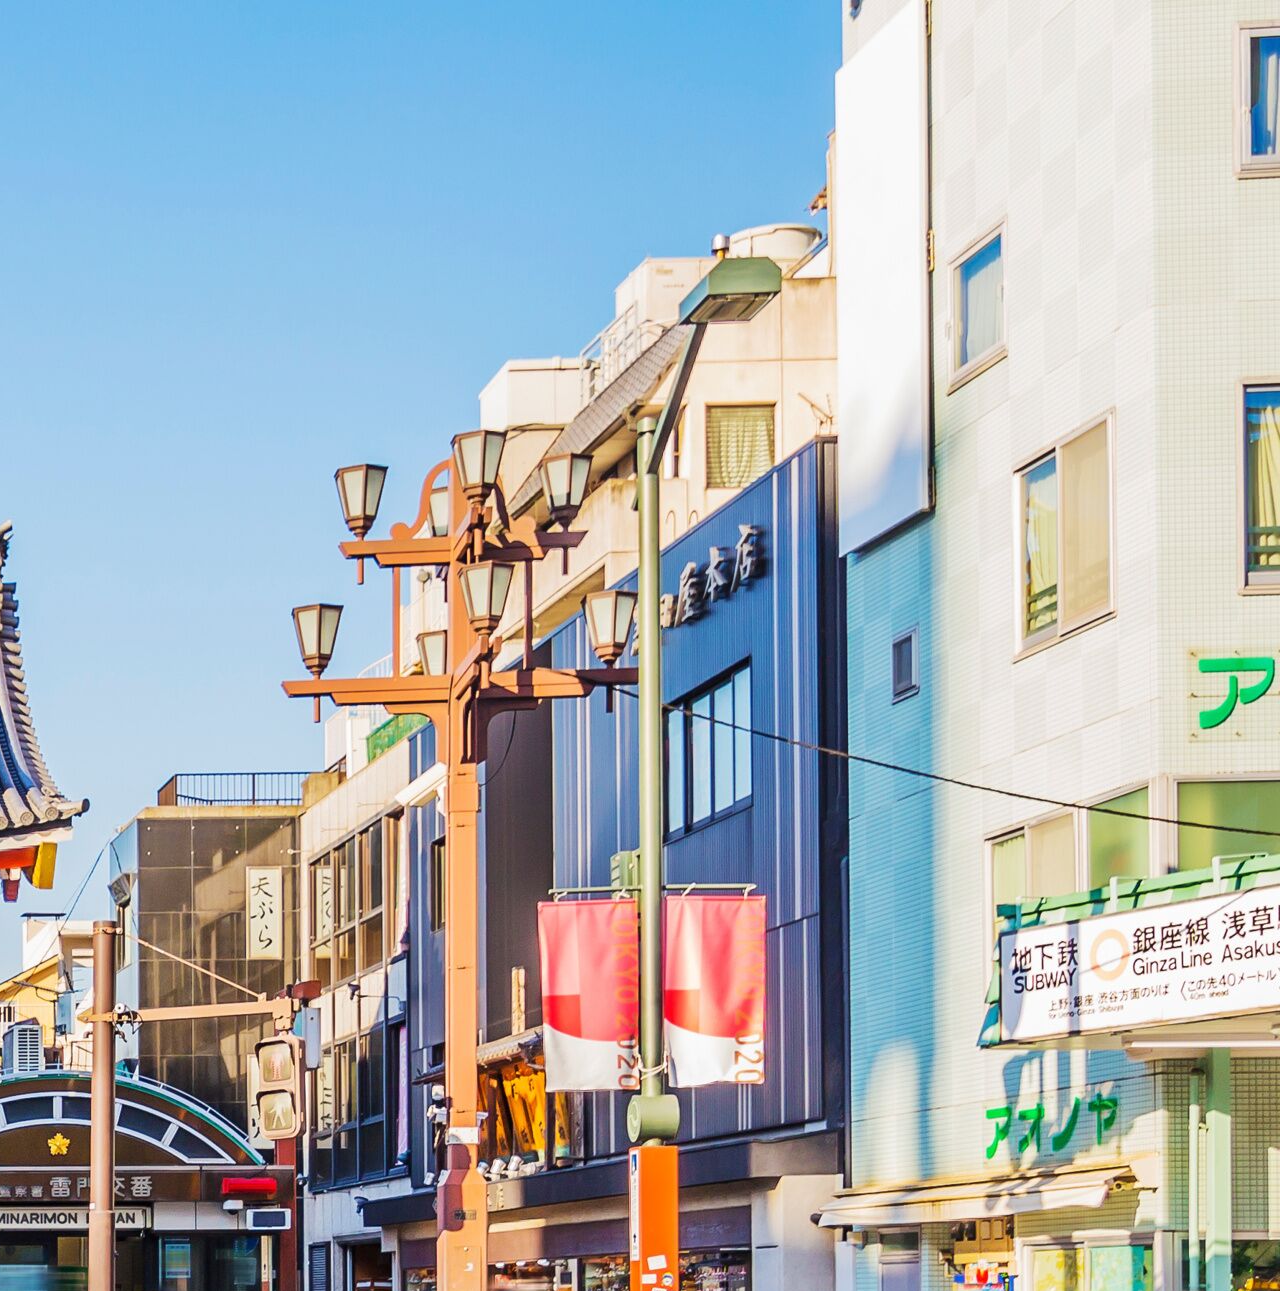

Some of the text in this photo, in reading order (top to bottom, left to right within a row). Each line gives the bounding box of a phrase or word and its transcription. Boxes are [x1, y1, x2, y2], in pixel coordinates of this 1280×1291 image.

[631, 523, 763, 656] 屋本店
[250, 876, 274, 950] 天ぷら
[1132, 903, 1280, 956] 銀座線 浅草
[1012, 938, 1078, 975] 地下鉄
[1014, 968, 1077, 994] SUBWAY
[1132, 956, 1177, 976] Ginza
[1181, 949, 1213, 968] Line
[985, 1093, 1118, 1160] アオノヤ
